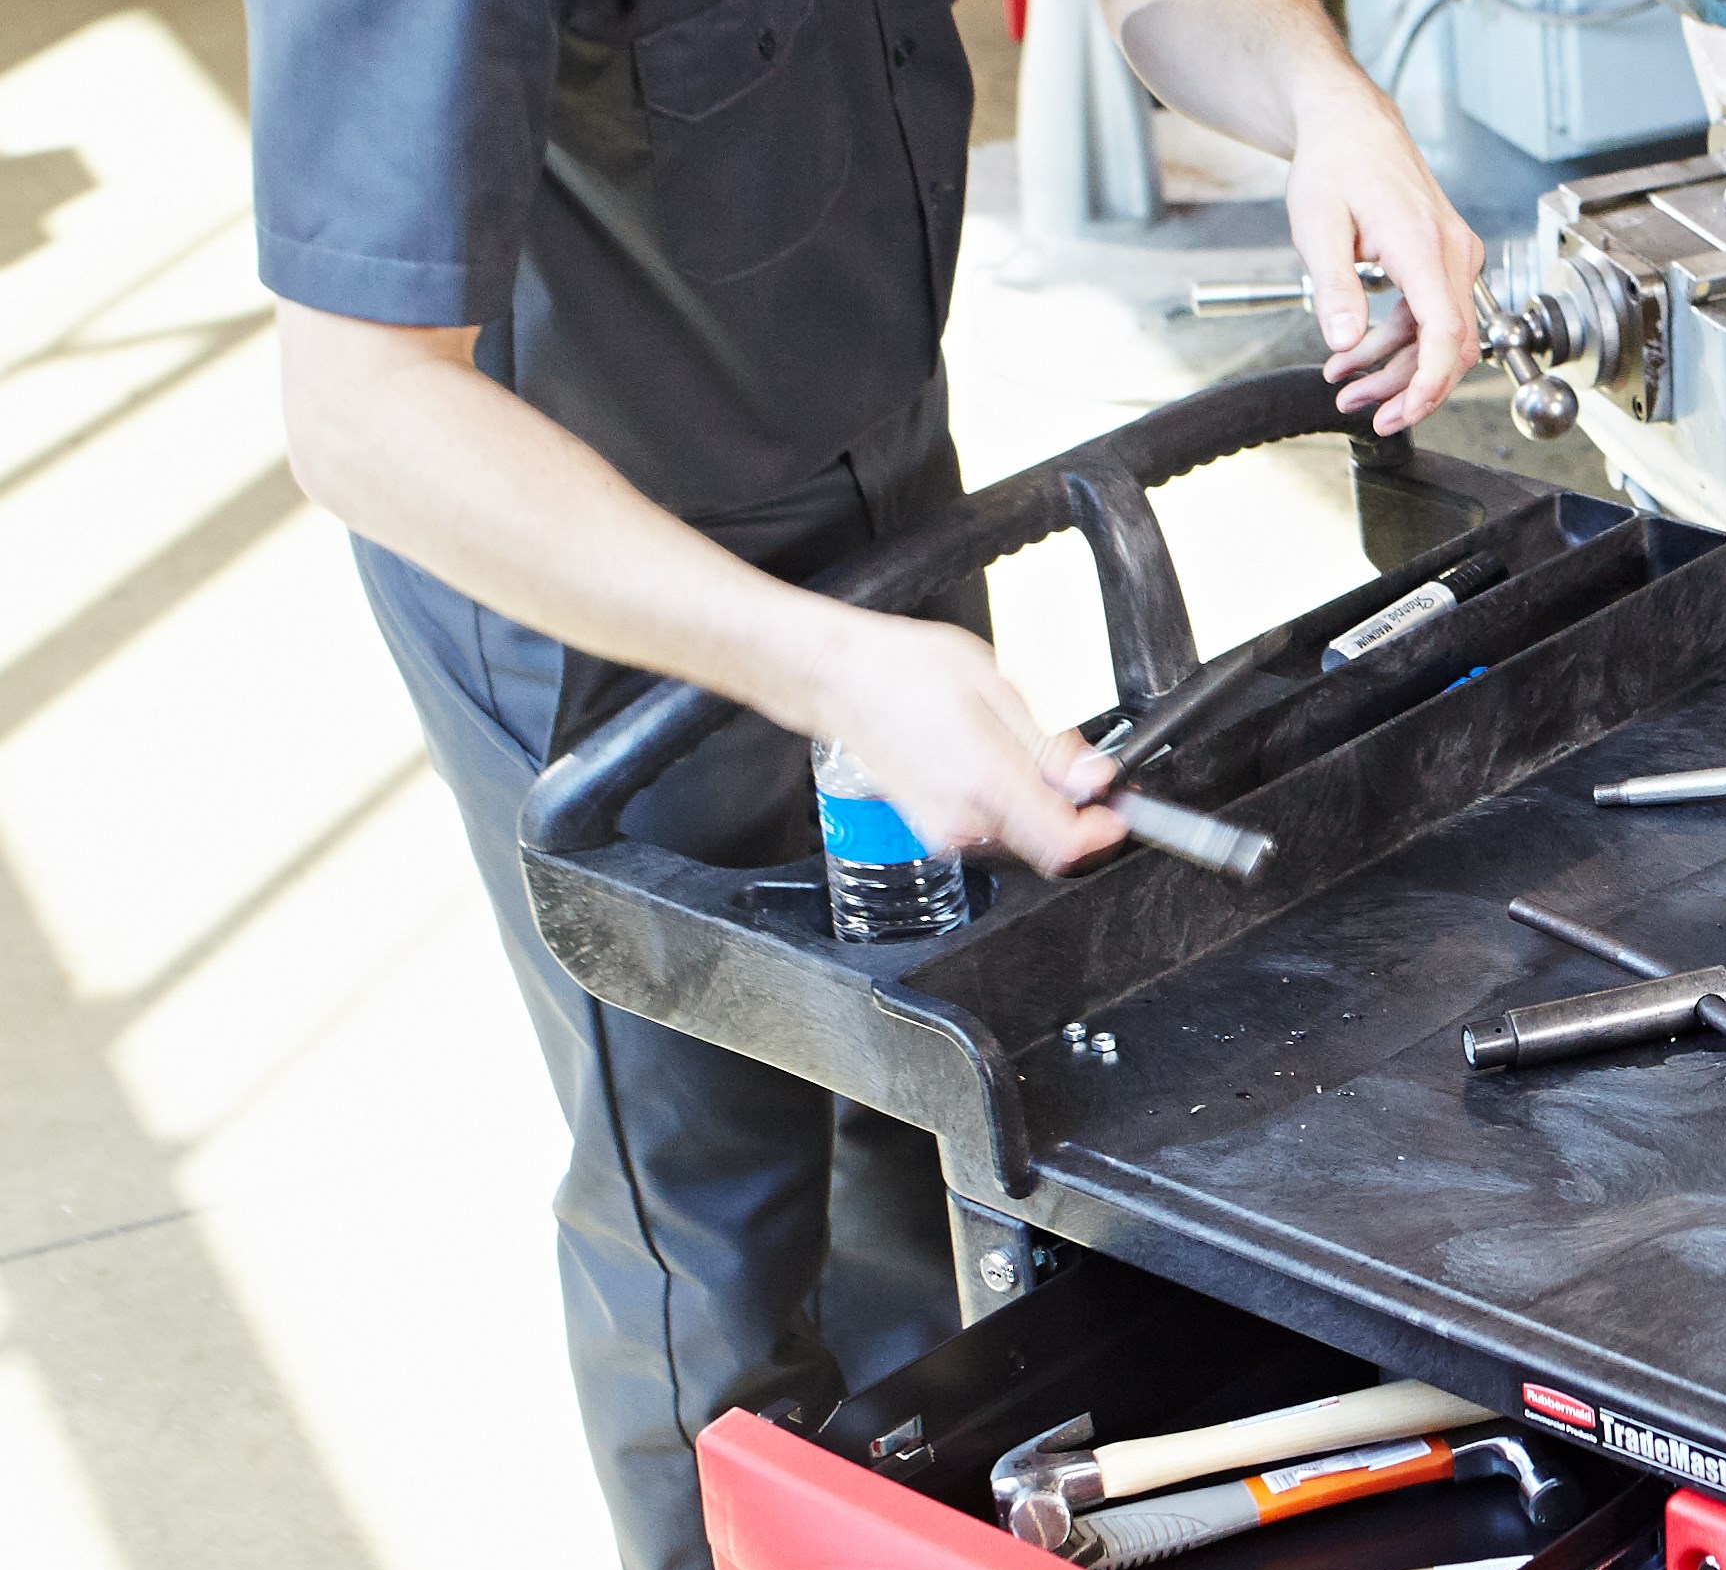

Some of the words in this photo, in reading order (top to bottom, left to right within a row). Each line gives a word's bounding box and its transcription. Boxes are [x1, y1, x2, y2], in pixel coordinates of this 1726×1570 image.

[1388, 594, 1435, 624] Sharpie
[1354, 622, 1394, 650] MAGNUM
[1526, 1388, 1592, 1423] Rubbermaid
